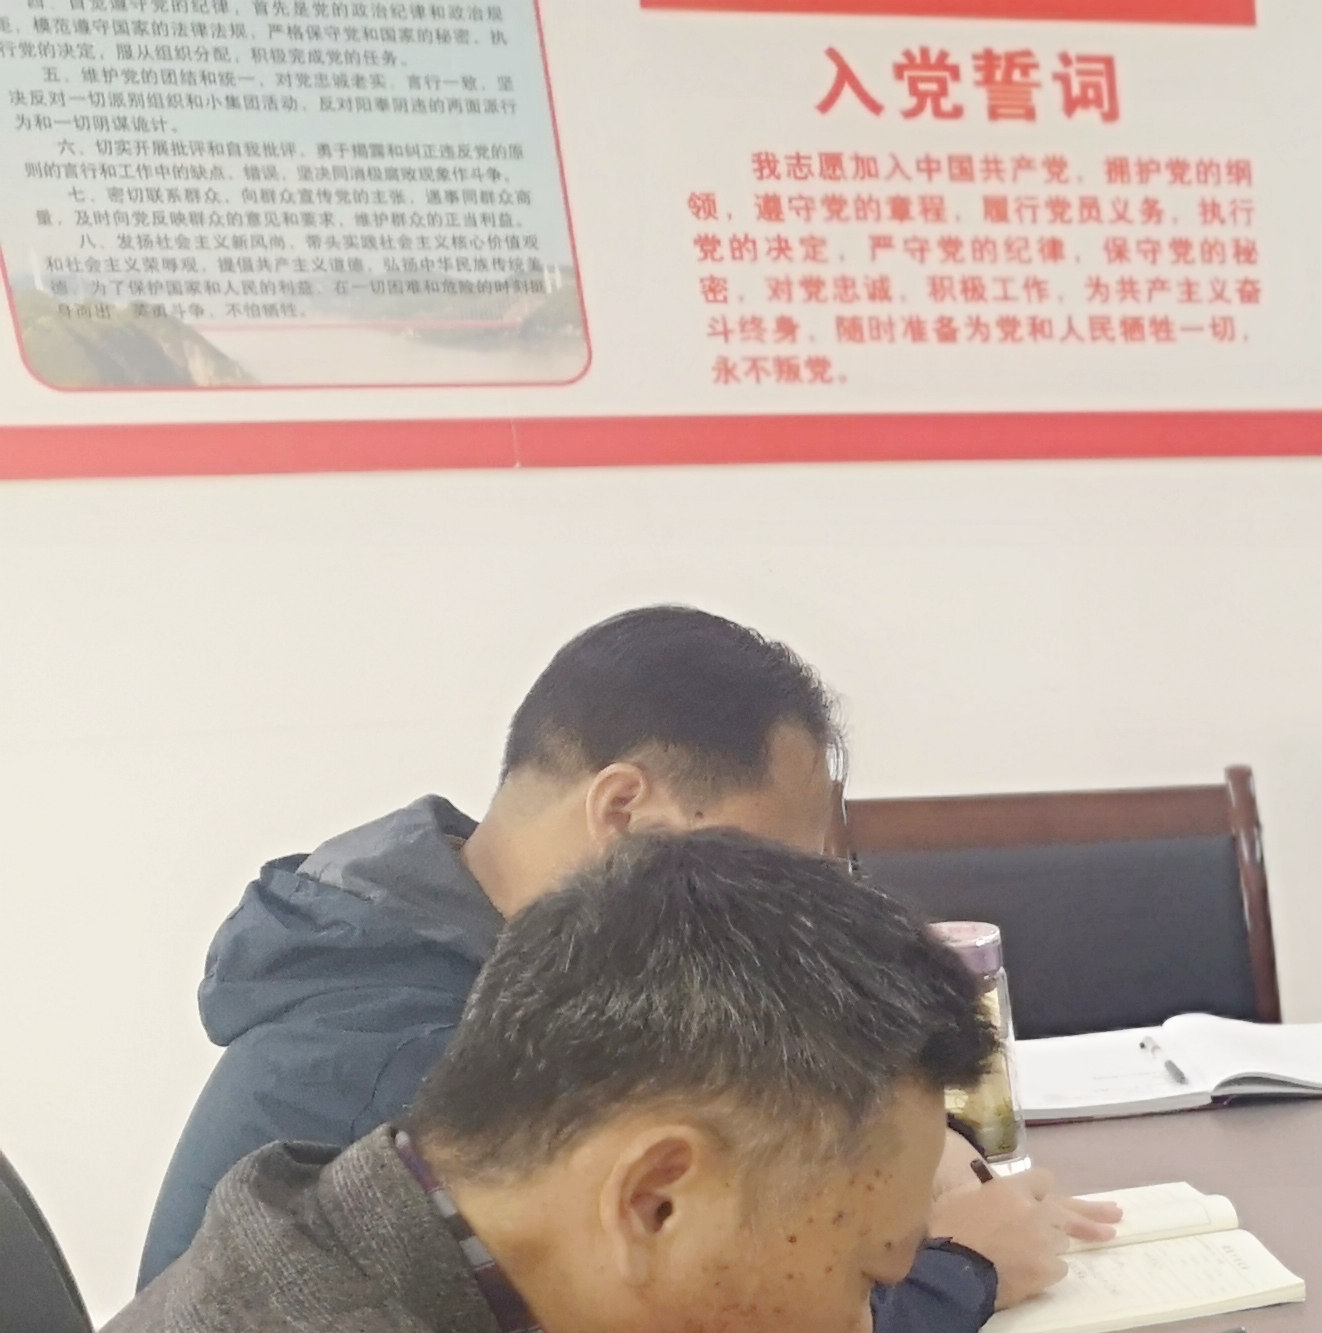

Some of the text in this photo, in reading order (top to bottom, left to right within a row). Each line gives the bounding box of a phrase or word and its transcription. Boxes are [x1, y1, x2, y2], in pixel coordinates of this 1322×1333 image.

[815, 46, 1121, 123] 入党誓词
[752, 151, 1252, 187] 我志愿加入中国共产党，拥护党的纲
[693, 233, 1258, 265] 党的决定，严守党的纪律，保守党的秘
[699, 274, 1261, 305] 密，对党忠诚，积极工作，为共产主义奋
[712, 356, 849, 385] 永不叛党。
